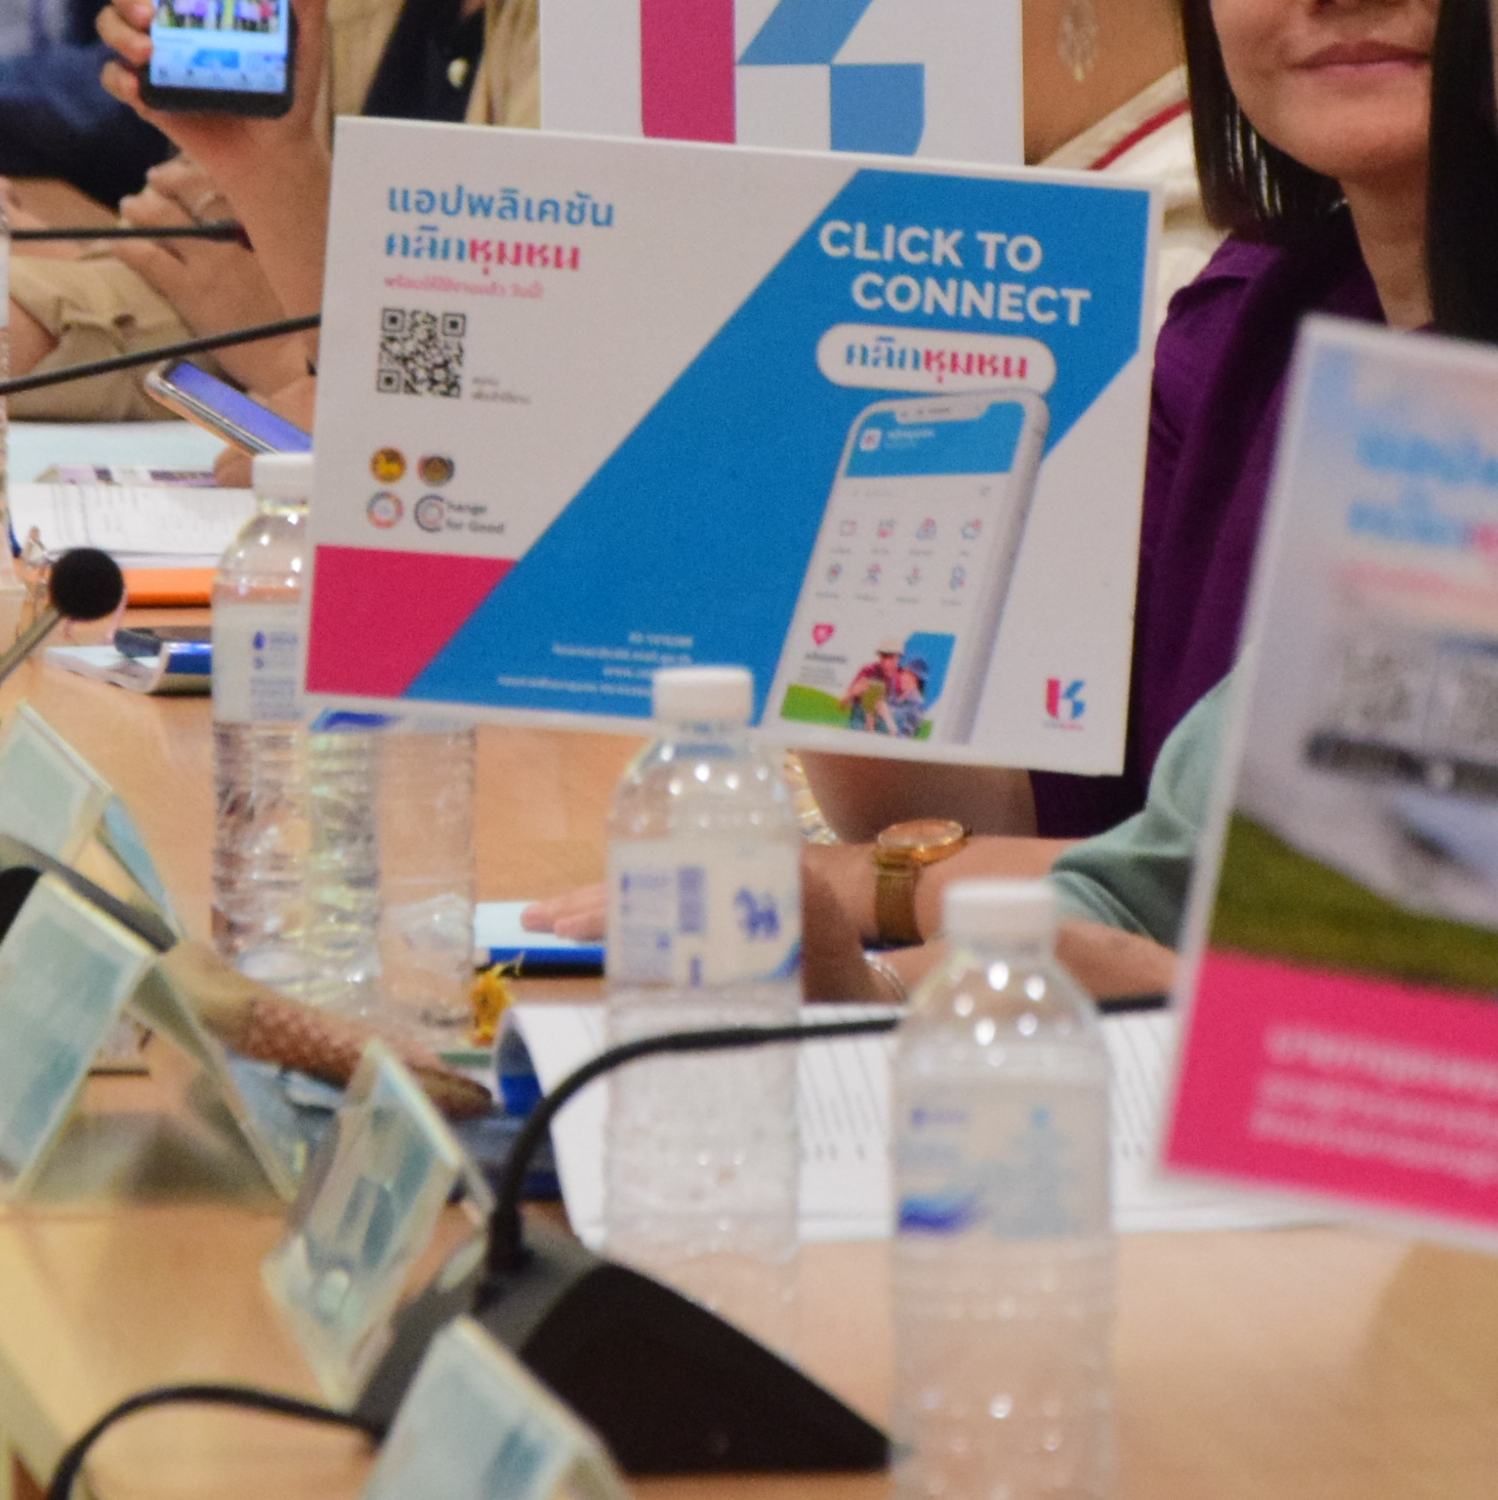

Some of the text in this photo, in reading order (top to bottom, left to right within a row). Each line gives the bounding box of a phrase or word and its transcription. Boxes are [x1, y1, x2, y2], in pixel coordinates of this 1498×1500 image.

[388, 184, 615, 228] แอปพลิเคชัน
[818, 220, 1043, 273] CLICK TO
[852, 271, 1092, 327] CONNECT
